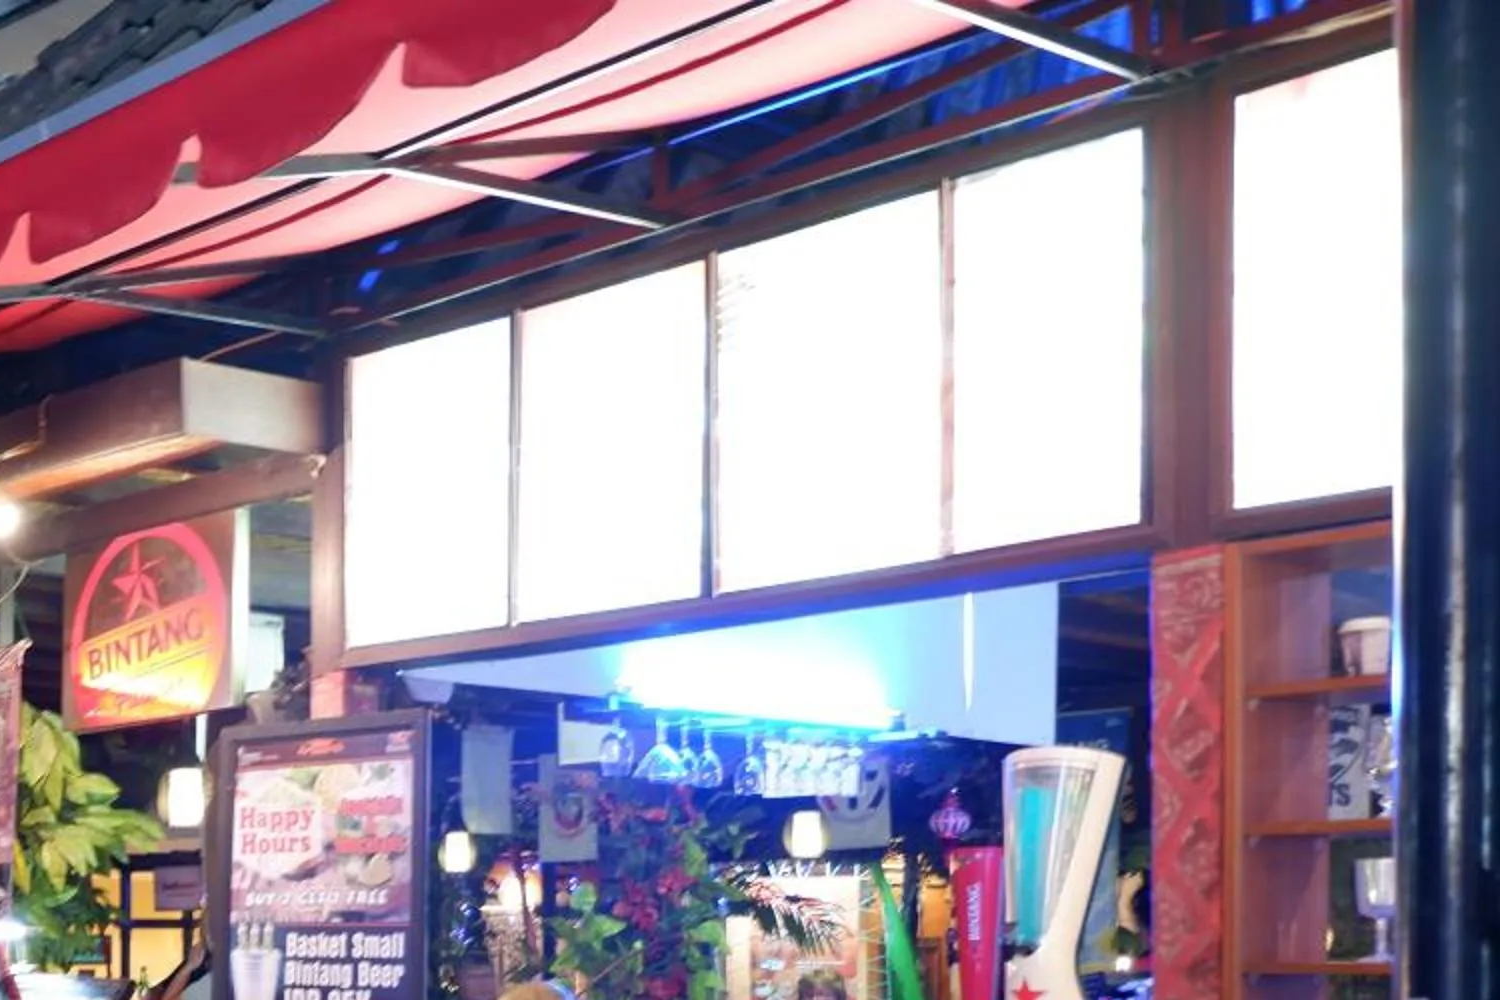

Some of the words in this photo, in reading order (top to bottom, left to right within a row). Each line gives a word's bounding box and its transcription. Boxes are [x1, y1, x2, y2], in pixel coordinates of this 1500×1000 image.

[88, 608, 203, 680] BINTANG
[239, 806, 315, 832] Happy
[241, 832, 312, 855] Hours
[346, 888, 389, 905] FREE
[285, 932, 348, 959] Basket
[351, 932, 405, 959] Small
[284, 960, 354, 989] Bintang
[357, 960, 405, 989] Beer
